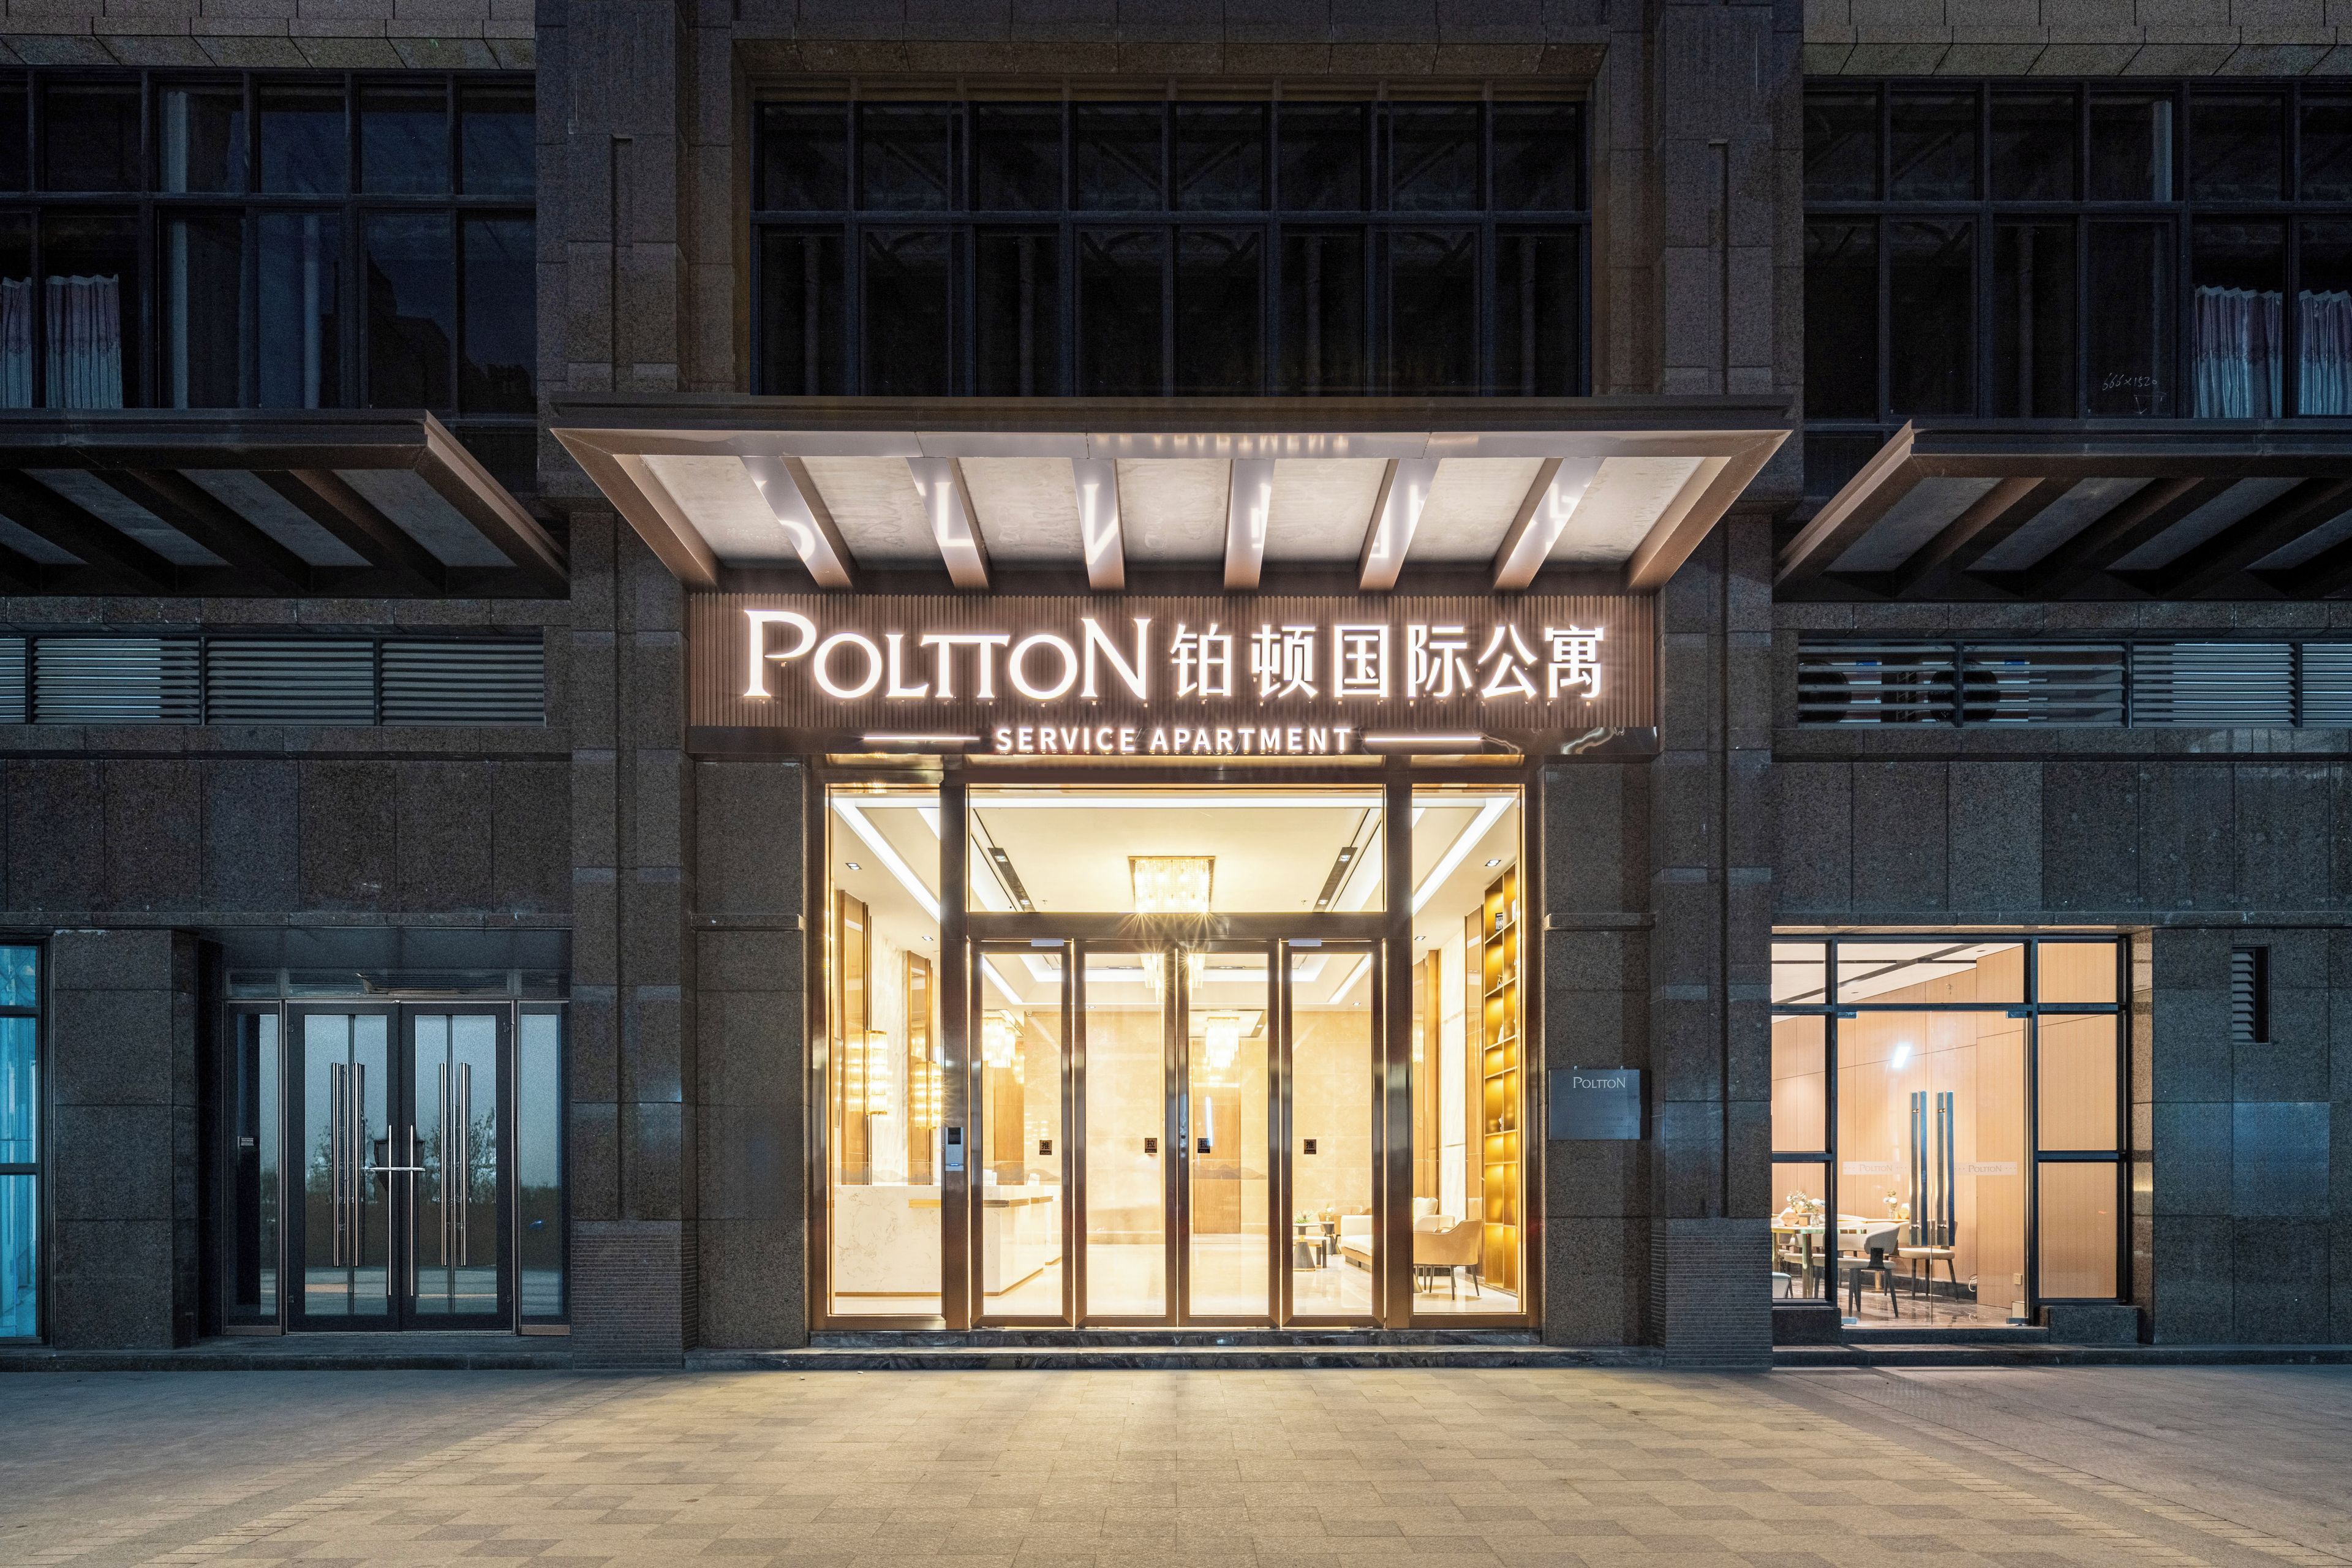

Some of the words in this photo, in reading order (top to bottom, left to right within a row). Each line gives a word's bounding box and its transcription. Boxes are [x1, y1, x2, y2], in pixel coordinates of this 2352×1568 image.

[1170, 623, 1604, 699] 铂顿国际公寓
[996, 728, 1135, 752] SERVICE
[1150, 728, 1351, 751] APARTMENT
[1041, 1141, 1050, 1150] 推
[1147, 1139, 1155, 1148] 拉
